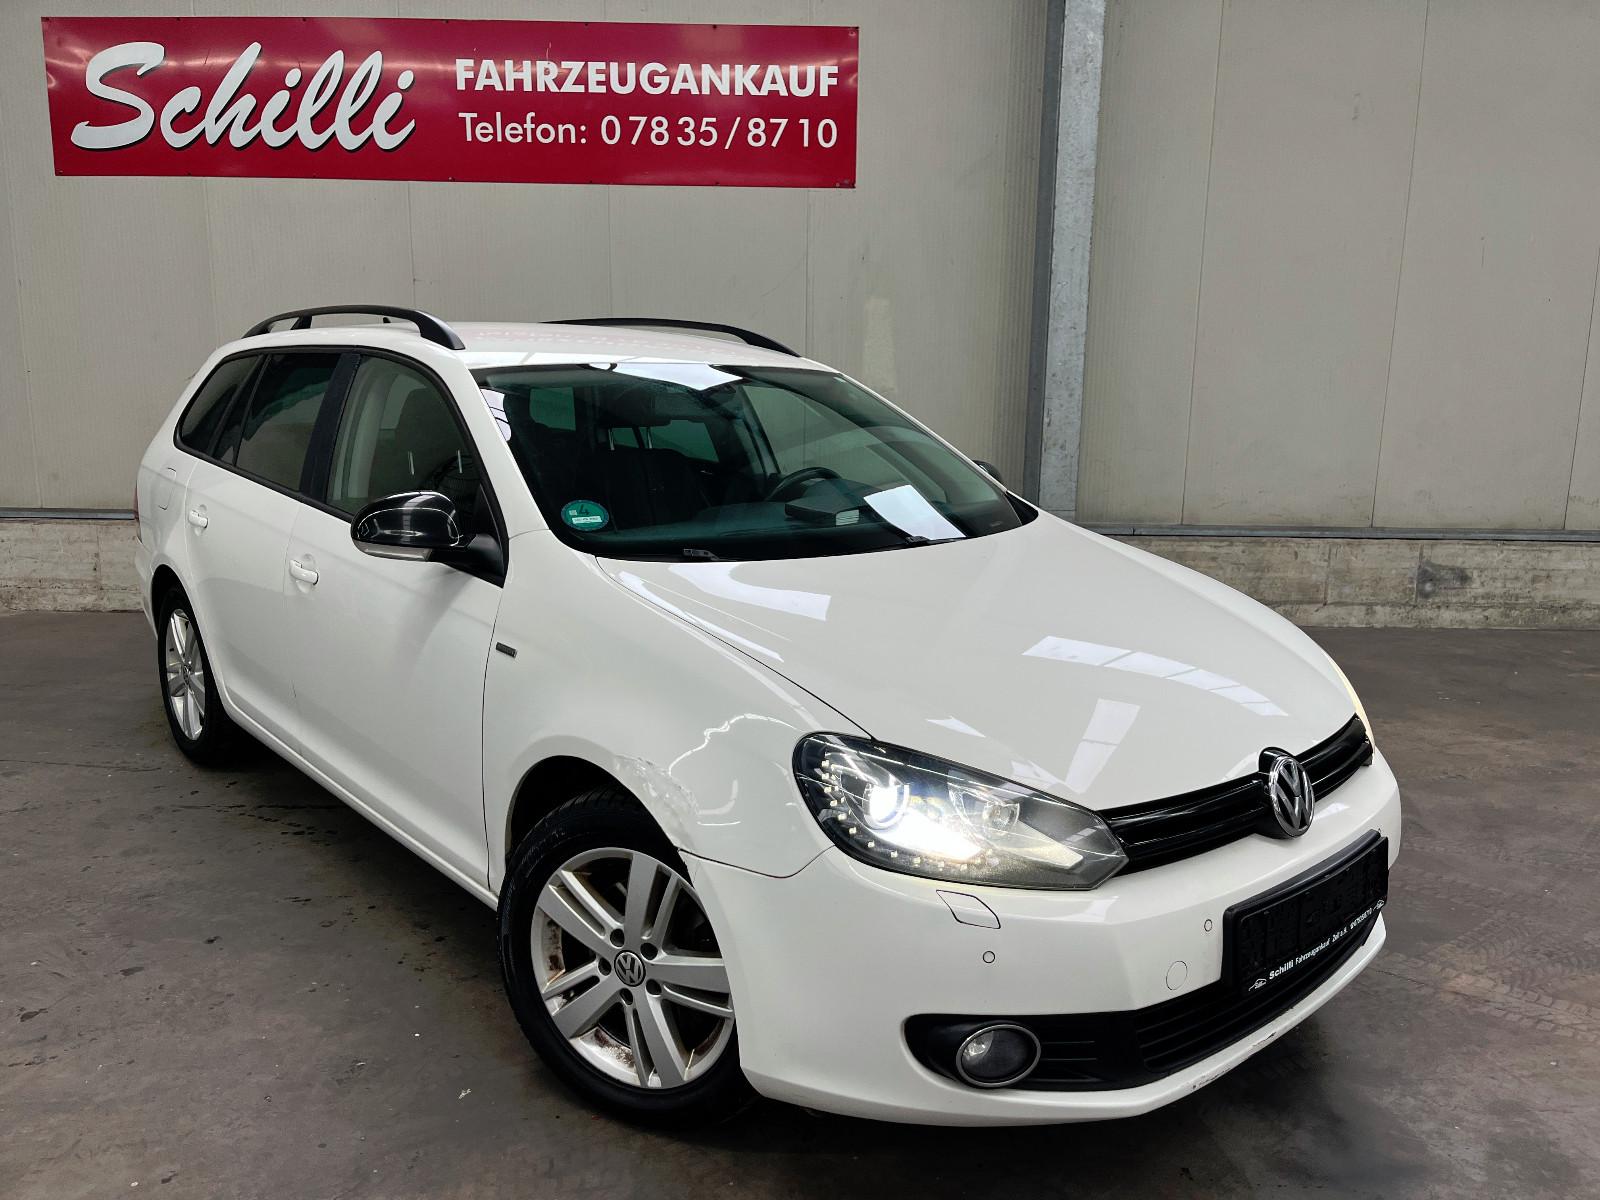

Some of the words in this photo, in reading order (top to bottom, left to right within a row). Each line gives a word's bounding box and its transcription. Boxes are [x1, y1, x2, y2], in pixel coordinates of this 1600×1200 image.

[455, 58, 839, 97] FAHRZEUGANKAUF
[70, 41, 416, 151] Schilli
[458, 111, 588, 144] Telefon:
[1268, 959, 1294, 980] Schilli
